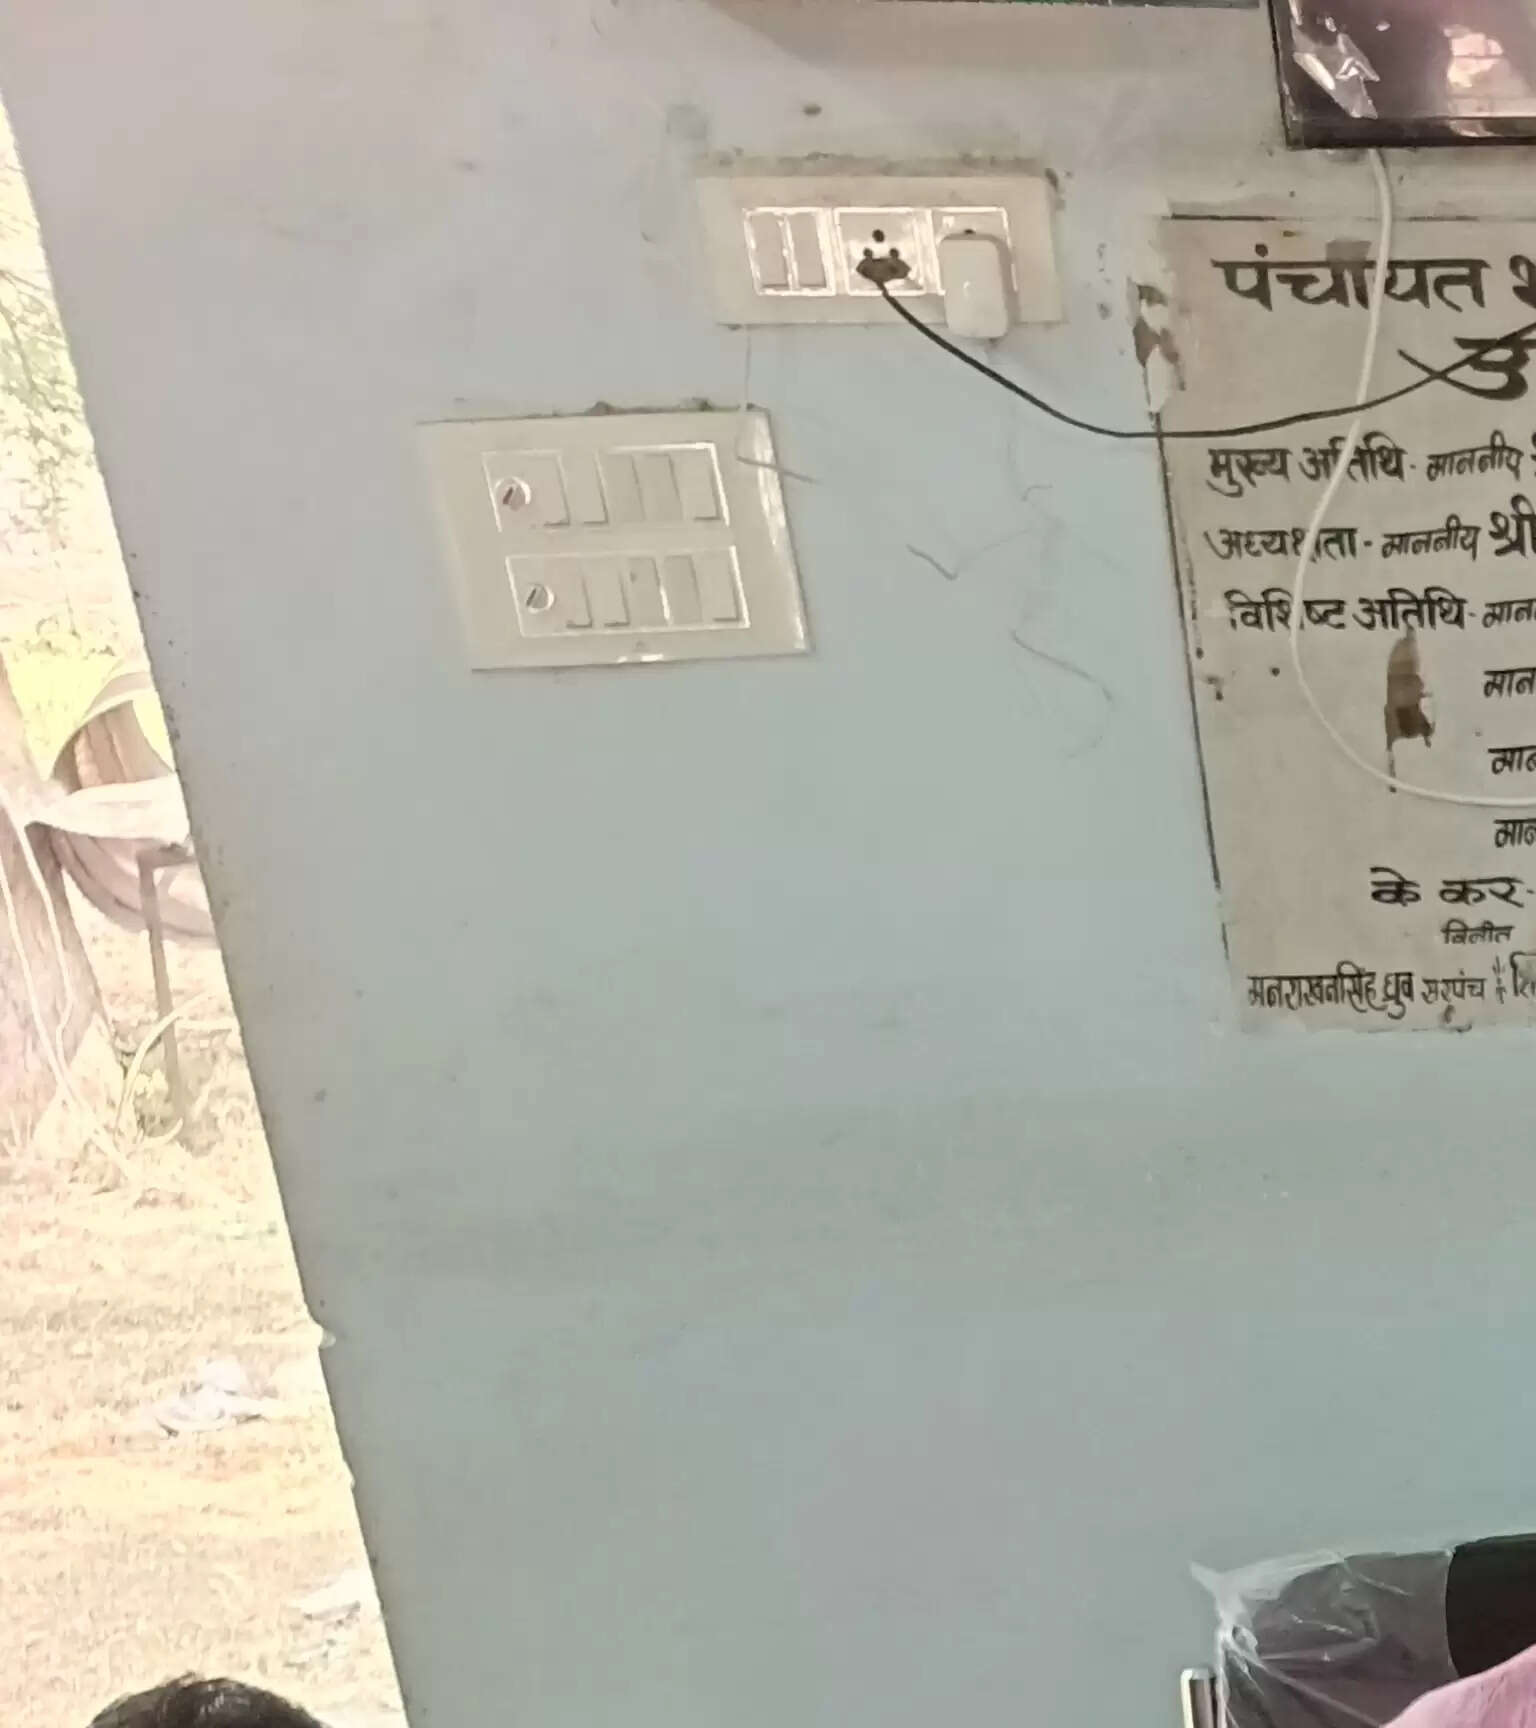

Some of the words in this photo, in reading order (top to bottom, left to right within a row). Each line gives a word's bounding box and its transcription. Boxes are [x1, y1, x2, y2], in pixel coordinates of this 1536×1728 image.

[1211, 244, 1491, 312] पंचायत
[1207, 447, 1293, 497] मुख्य
[1426, 430, 1524, 482] माननीय
[1382, 513, 1482, 561] माननीय
[1352, 586, 1468, 631] अतिथि
[1370, 866, 1421, 906] के
